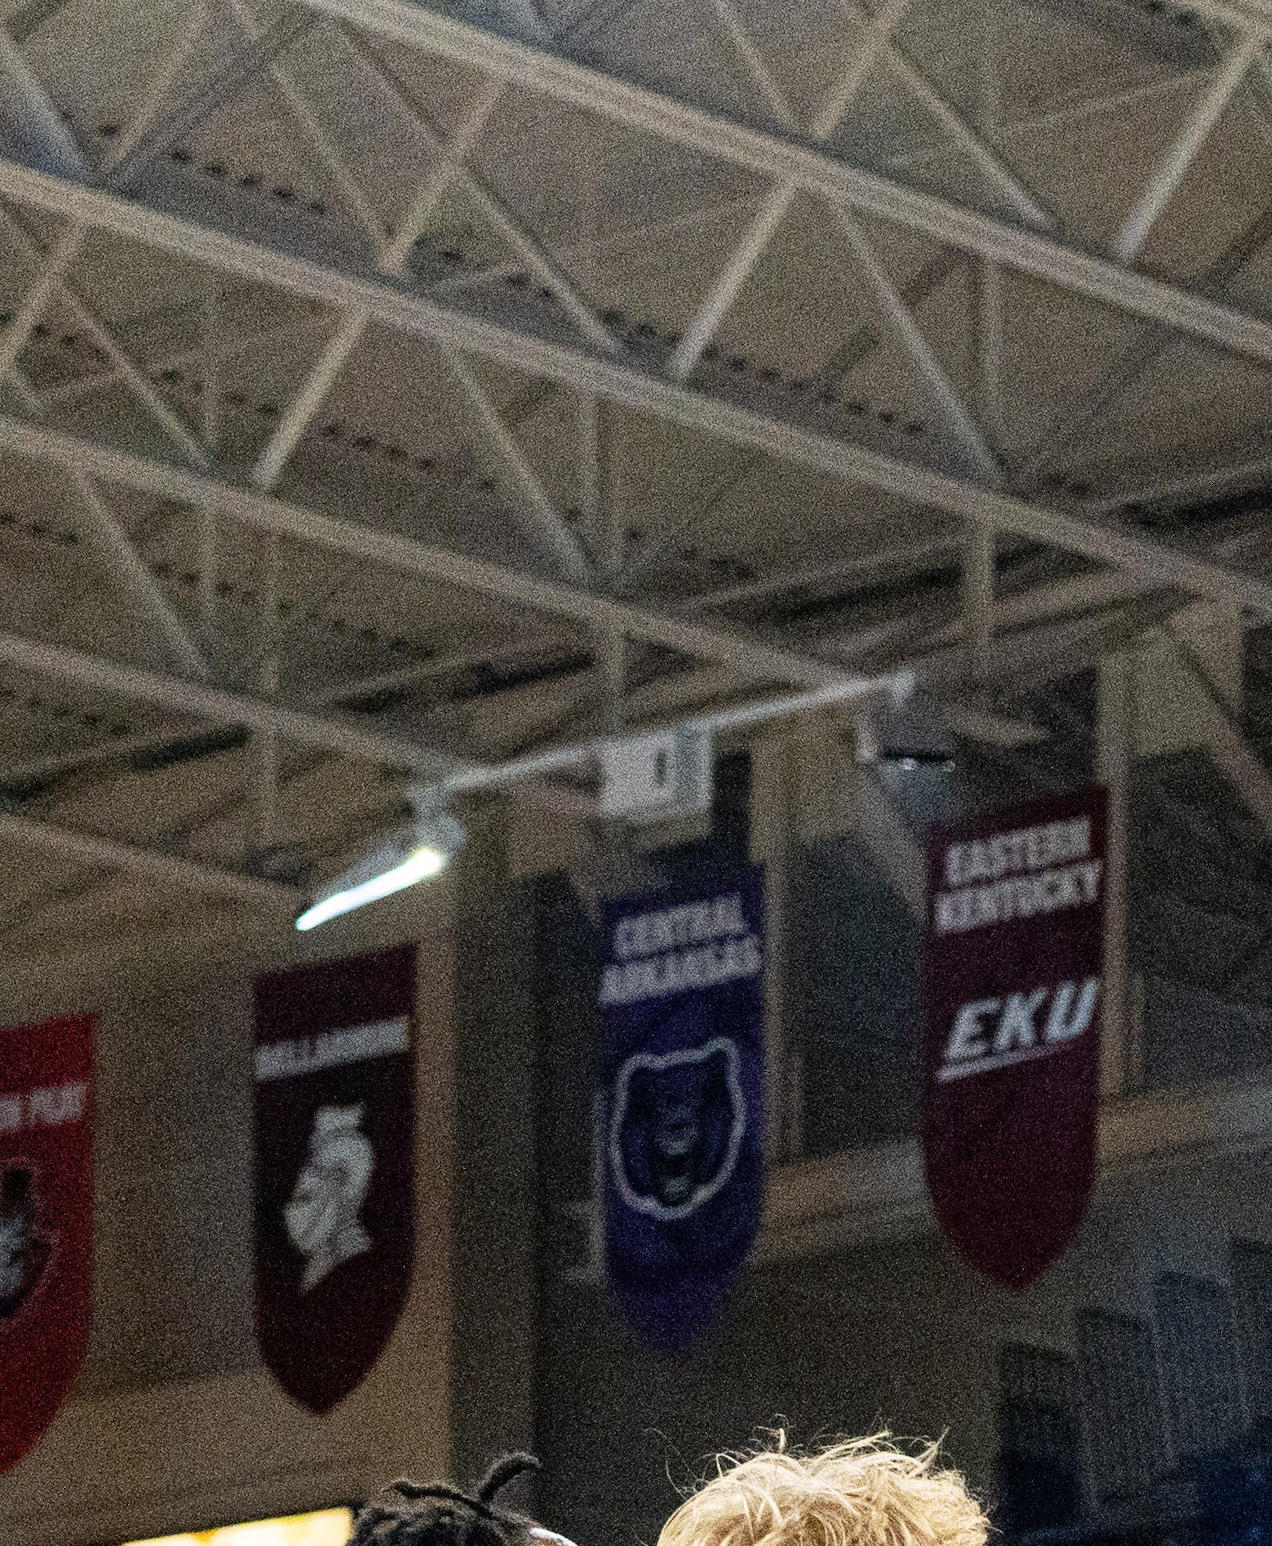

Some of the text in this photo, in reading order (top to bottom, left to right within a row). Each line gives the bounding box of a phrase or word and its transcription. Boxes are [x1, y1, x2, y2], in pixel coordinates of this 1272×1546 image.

[946, 814, 1092, 887] EASTERN
[934, 859, 1103, 935] KENTUCKY
[944, 978, 1102, 1065] EKU
